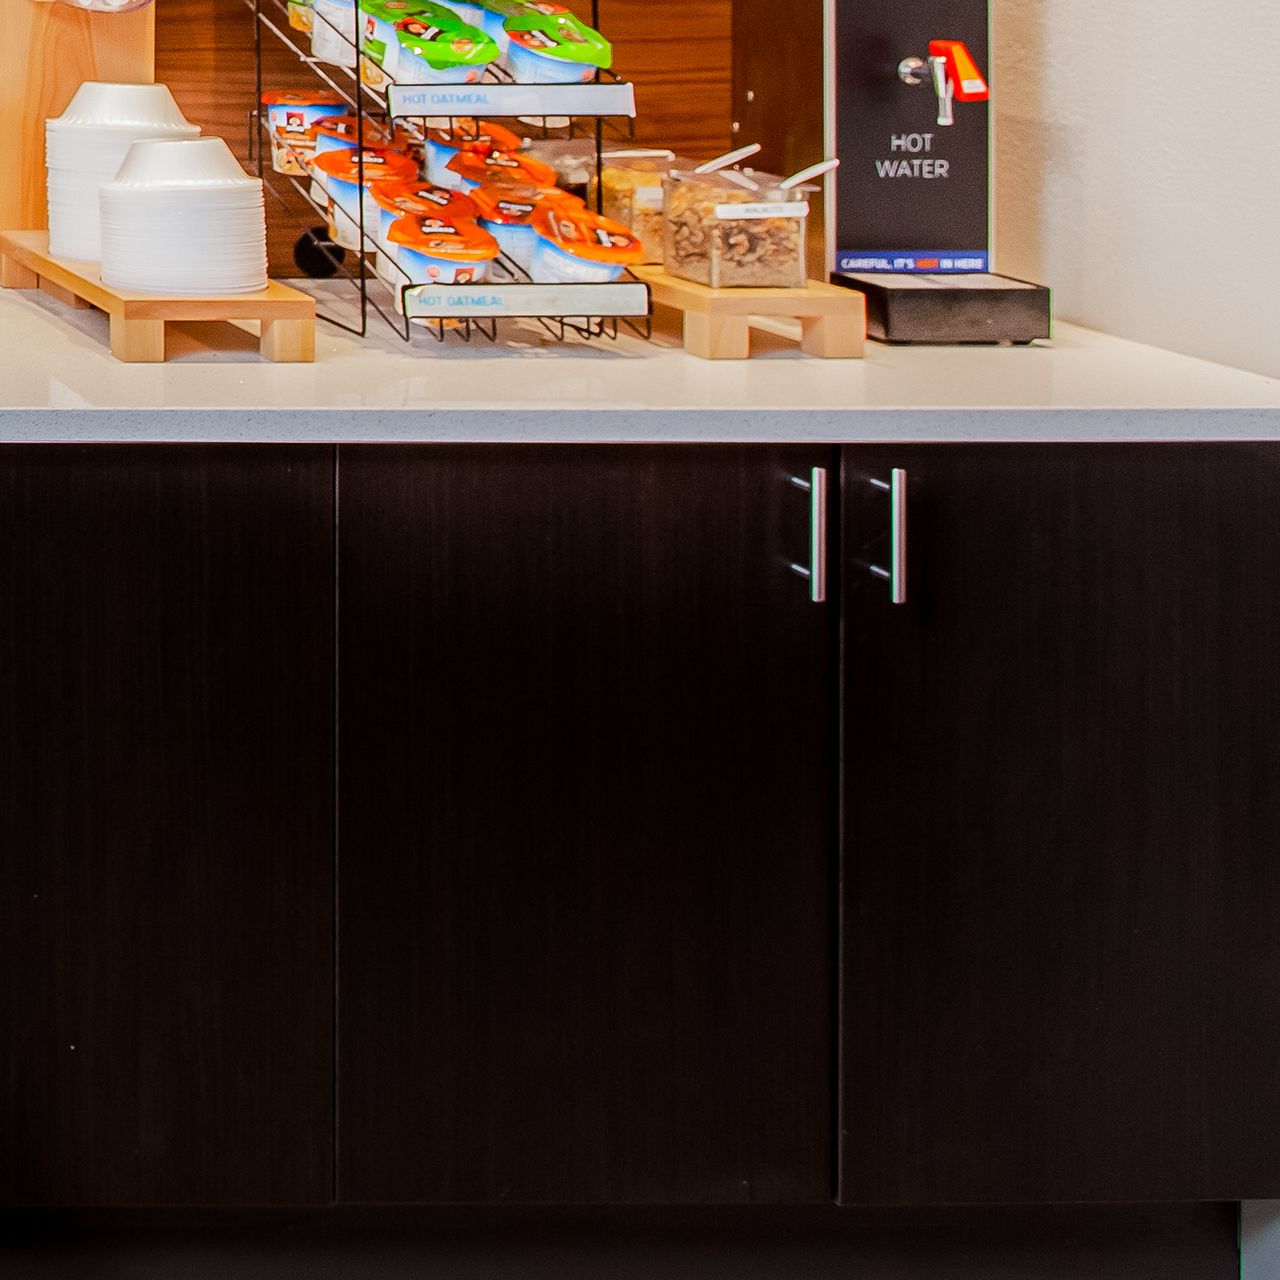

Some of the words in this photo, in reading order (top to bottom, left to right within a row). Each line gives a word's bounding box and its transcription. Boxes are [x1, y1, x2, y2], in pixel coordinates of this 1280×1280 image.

[402, 93, 428, 105] HOT
[431, 93, 488, 105] OATMEAL
[890, 132, 935, 153] HOT
[875, 159, 950, 179] WATER
